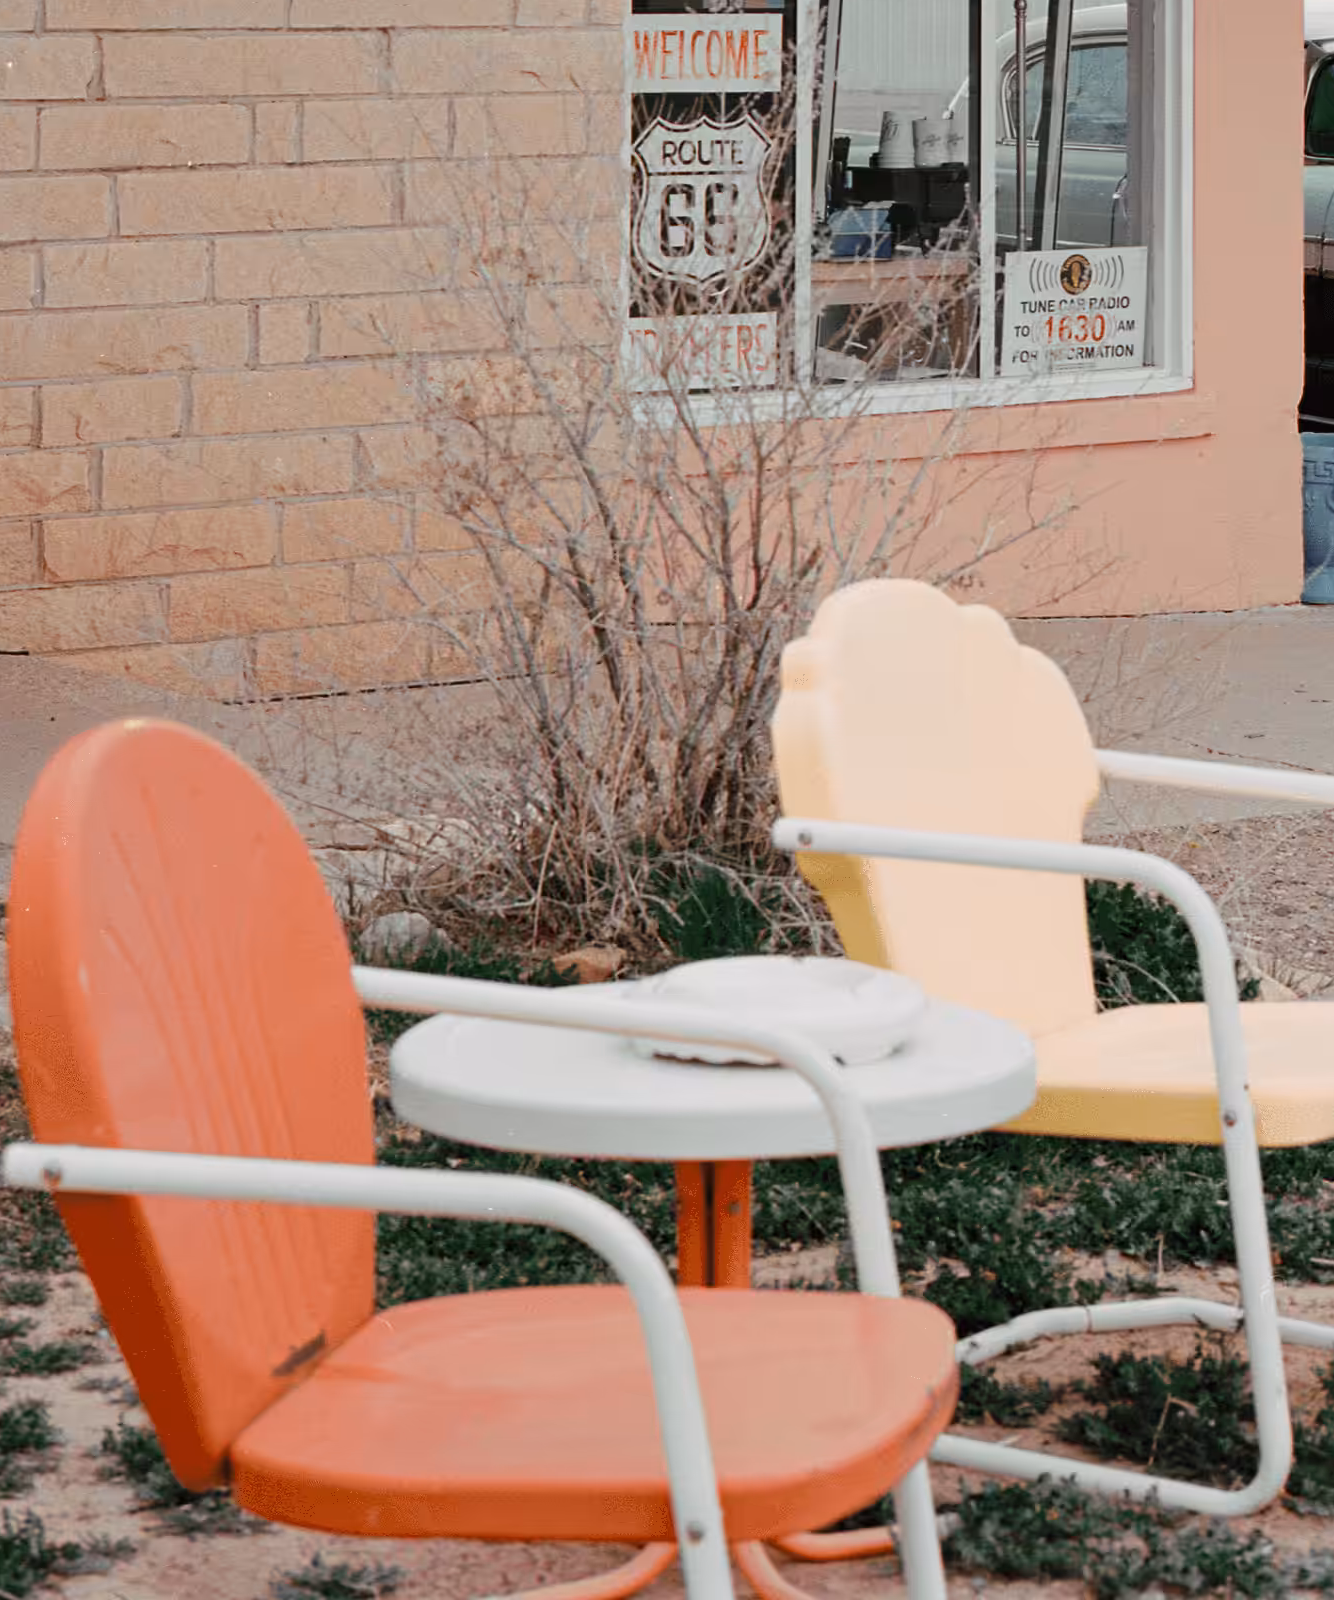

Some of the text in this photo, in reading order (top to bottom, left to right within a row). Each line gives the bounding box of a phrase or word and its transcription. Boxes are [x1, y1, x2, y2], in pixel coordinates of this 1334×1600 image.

[633, 29, 771, 80] WELCOME
[660, 139, 744, 167] ROUTE
[659, 182, 739, 258] 66
[1020, 296, 1130, 314] TUNE CAR RADIO
[1014, 314, 1135, 344] TO 1630 AM
